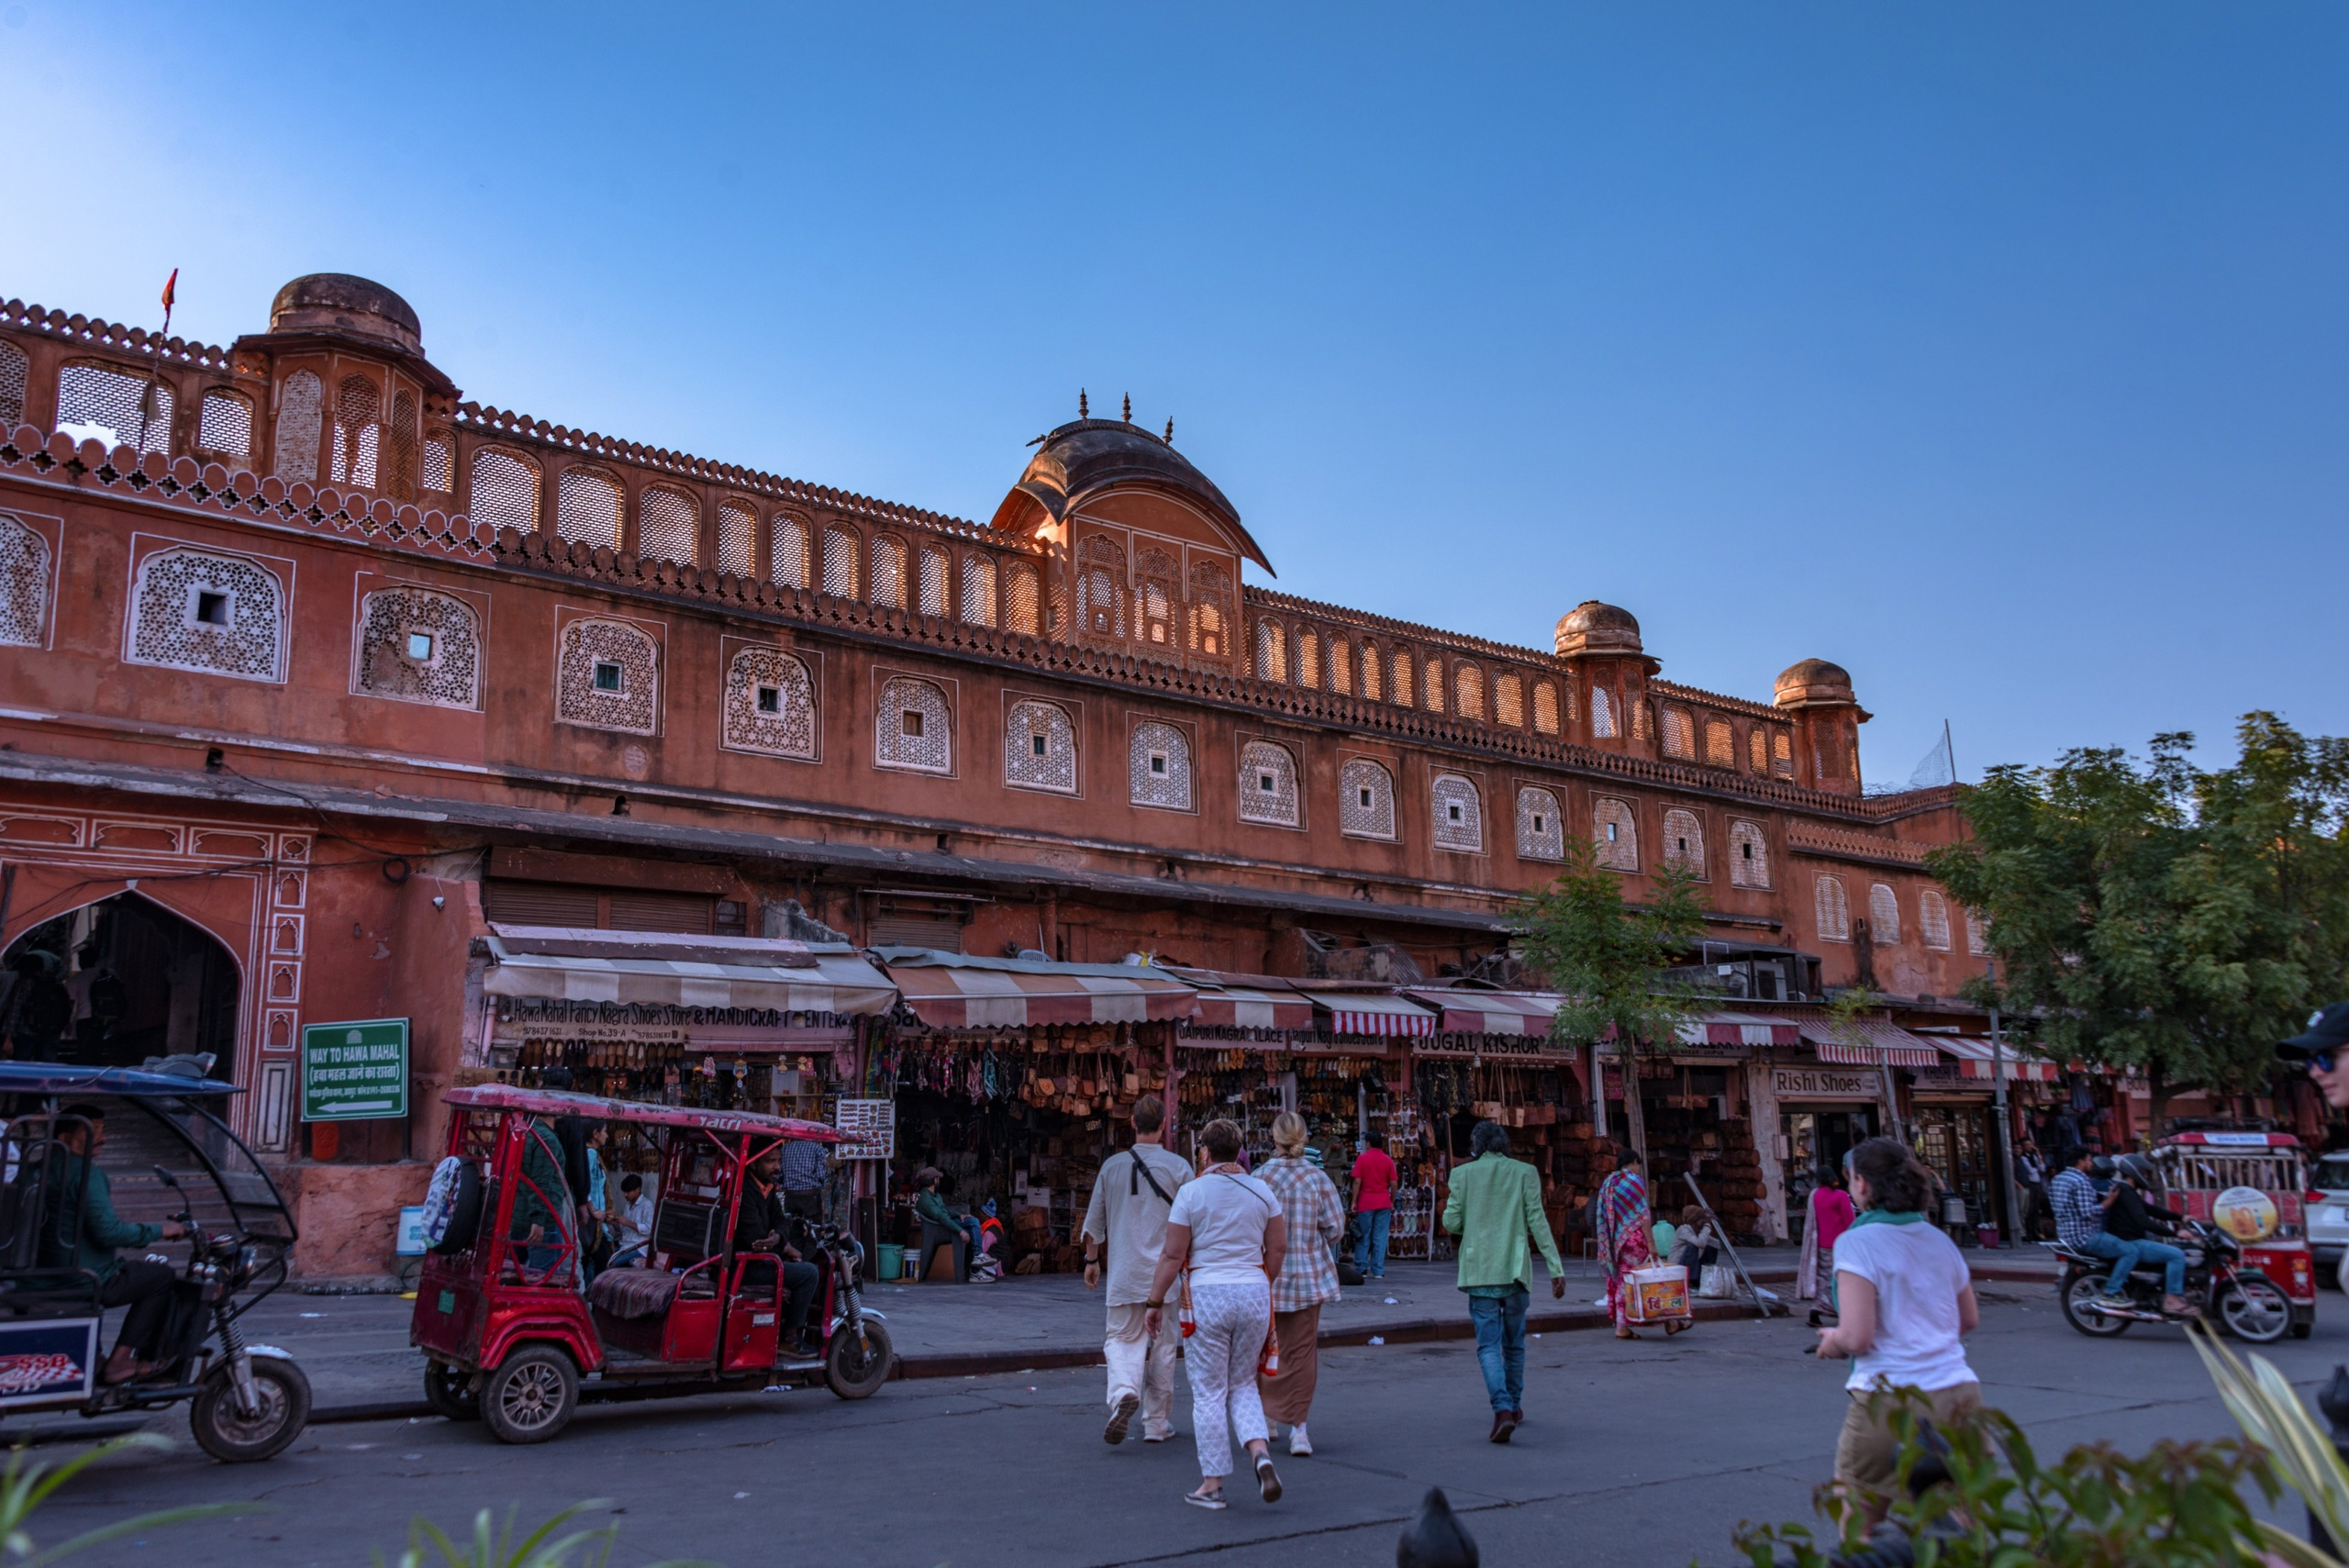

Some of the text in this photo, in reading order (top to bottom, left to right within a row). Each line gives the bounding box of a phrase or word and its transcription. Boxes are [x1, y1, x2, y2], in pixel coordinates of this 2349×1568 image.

[570, 1001, 596, 1024] Fancy
[599, 1002, 629, 1026] Nagra
[632, 1003, 662, 1026] Shoes
[663, 1005, 692, 1026] Store
[706, 1006, 790, 1028] HANDICRAFT
[804, 1010, 841, 1029] ENTER
[579, 1028, 596, 1038] Shop
[1215, 1025, 1245, 1041] NAGRA
[310, 1044, 400, 1063] WAY TO HAWA MAHAL
[1419, 1033, 1477, 1052] JUGAL
[1482, 1035, 1541, 1055] KISHOR
[1776, 1072, 1817, 1092] Rishi
[1820, 1073, 1861, 1092] Shoes
